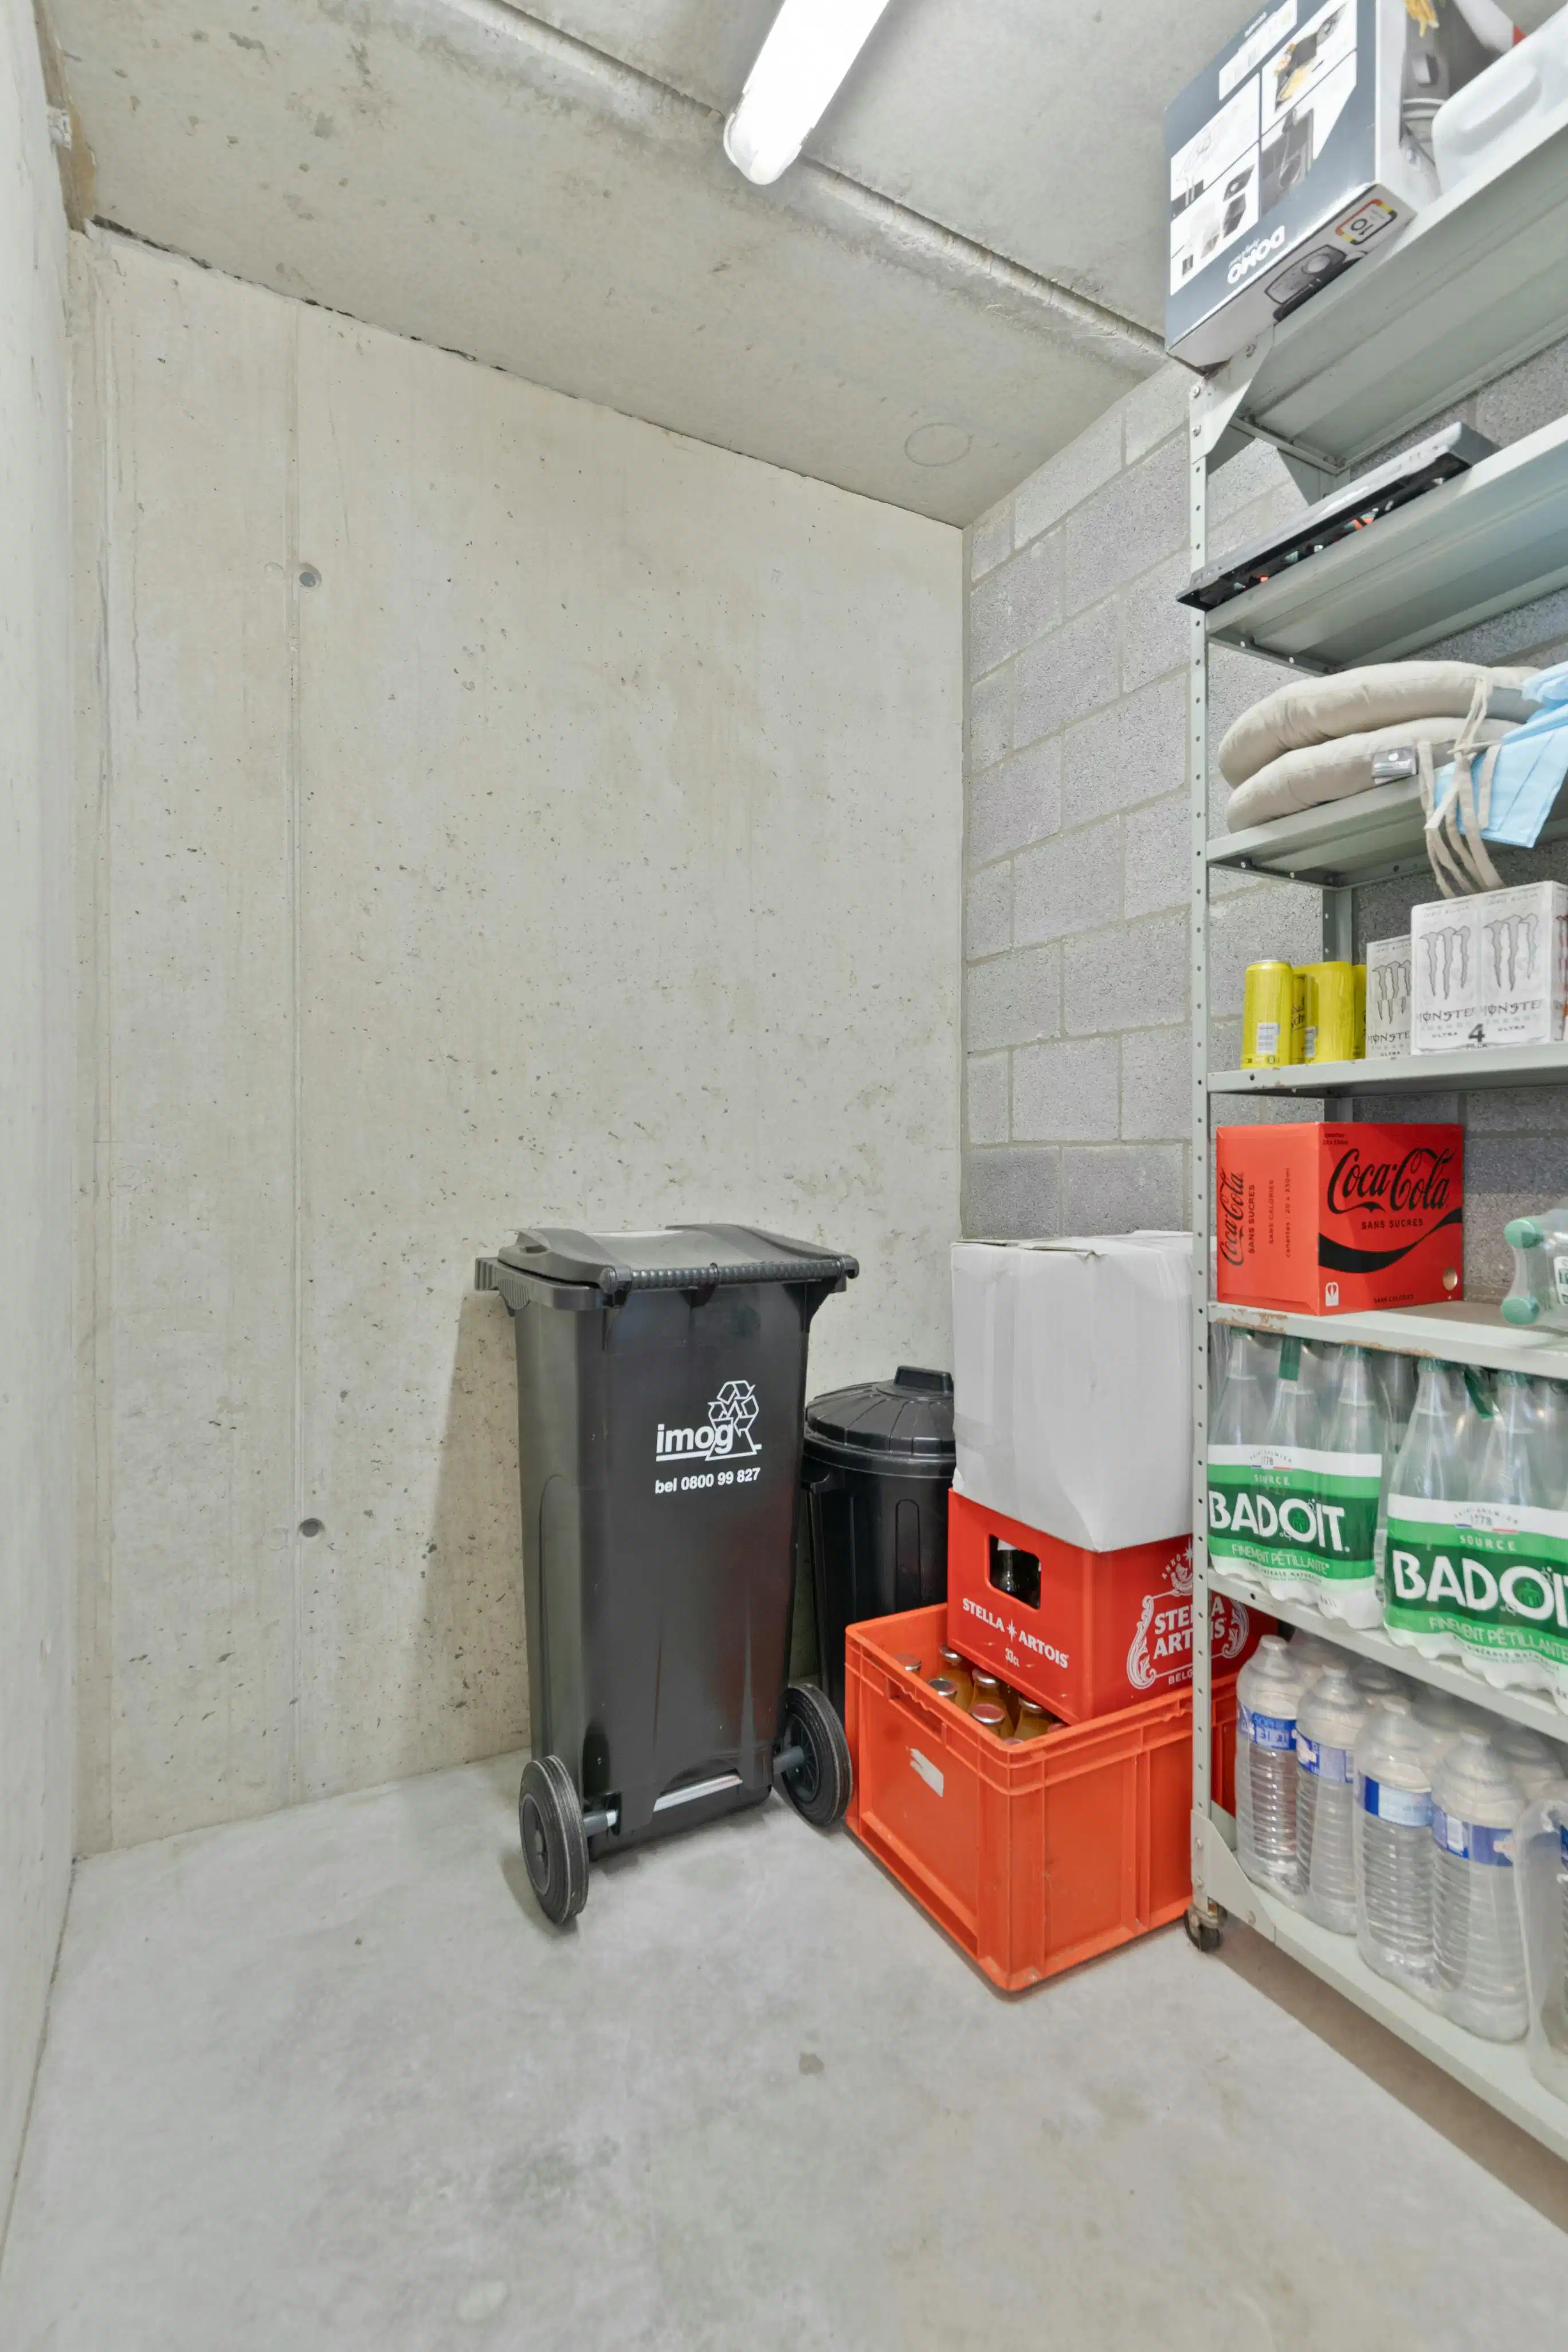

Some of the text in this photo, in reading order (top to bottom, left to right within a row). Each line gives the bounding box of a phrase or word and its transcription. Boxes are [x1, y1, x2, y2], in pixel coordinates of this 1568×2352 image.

[1228, 225, 1285, 284] DOMO
[1468, 1023, 1485, 1042] 4
[1327, 1148, 1456, 1214] Coca-Cola
[1220, 1167, 1244, 1266] Coca-Cola
[1361, 1218, 1424, 1230] SANS SUCRES
[656, 1424, 734, 1454] imog
[655, 1467, 761, 1493] bel 0800 99 827
[1254, 1473, 1291, 1485] SOURCE
[1208, 1490, 1346, 1552] BADOIT
[1459, 1534, 1516, 1552] SOURCE
[1162, 1554, 1181, 1580] ANNO
[1155, 1596, 1225, 1634] STEA
[962, 1597, 1068, 1668] STELLA ARTOIS
[1153, 1618, 1225, 1660] ARTIS
